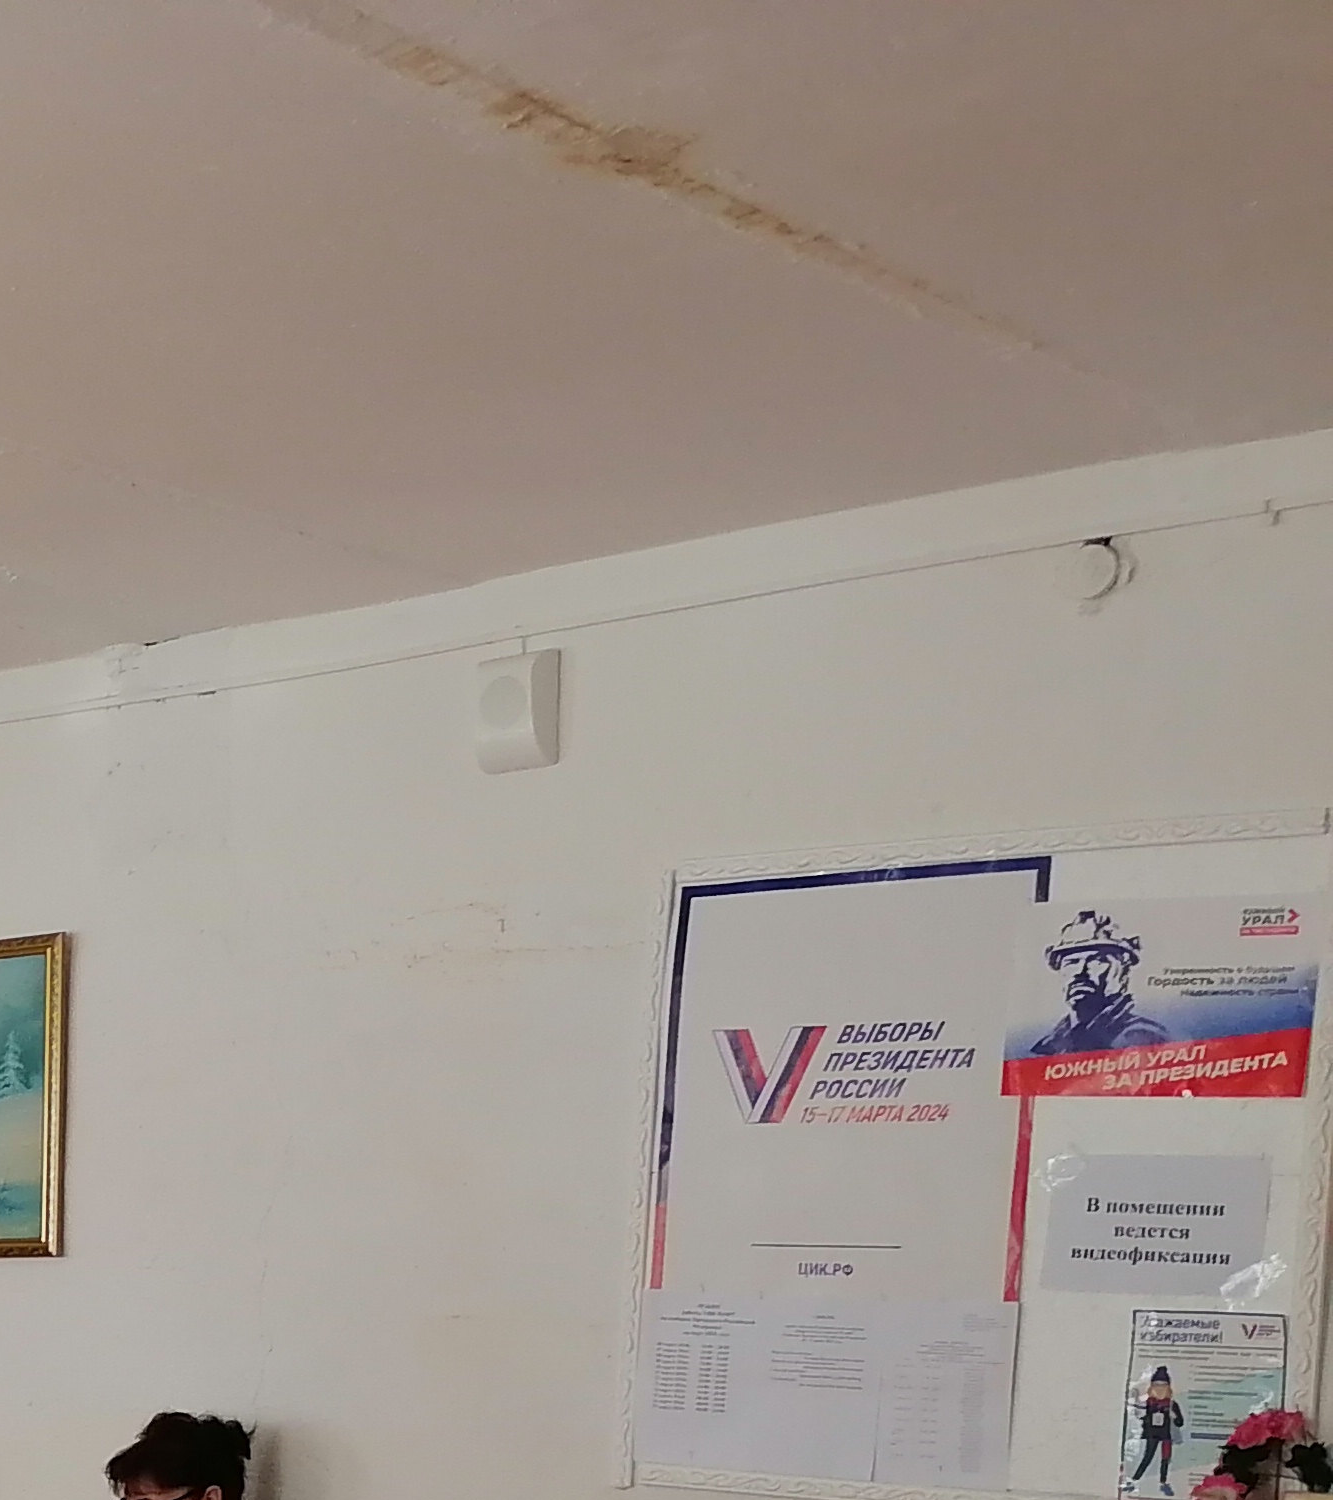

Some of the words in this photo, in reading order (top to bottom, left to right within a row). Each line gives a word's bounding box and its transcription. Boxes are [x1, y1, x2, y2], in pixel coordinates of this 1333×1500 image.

[1242, 914, 1285, 926] УРАЛ
[1147, 975, 1215, 988] Гордость
[837, 1021, 945, 1044] ВЫБОРЫ
[823, 1047, 976, 1073] ПРЕЗИДЕНТА
[1044, 1053, 1141, 1080] ЮЖНЫЙ
[1147, 1045, 1207, 1068] УРАЛ
[1102, 1074, 1133, 1090] ЗА
[1138, 1051, 1288, 1087] ПРЕЗИДЕНТА
[809, 1078, 908, 1100] РОССИИ
[846, 1104, 905, 1123] МАРТА
[906, 1103, 950, 1122] 2024
[1086, 1197, 1100, 1213] В
[1113, 1225, 1191, 1240] ведется
[1070, 1246, 1232, 1266] видеофиксация
